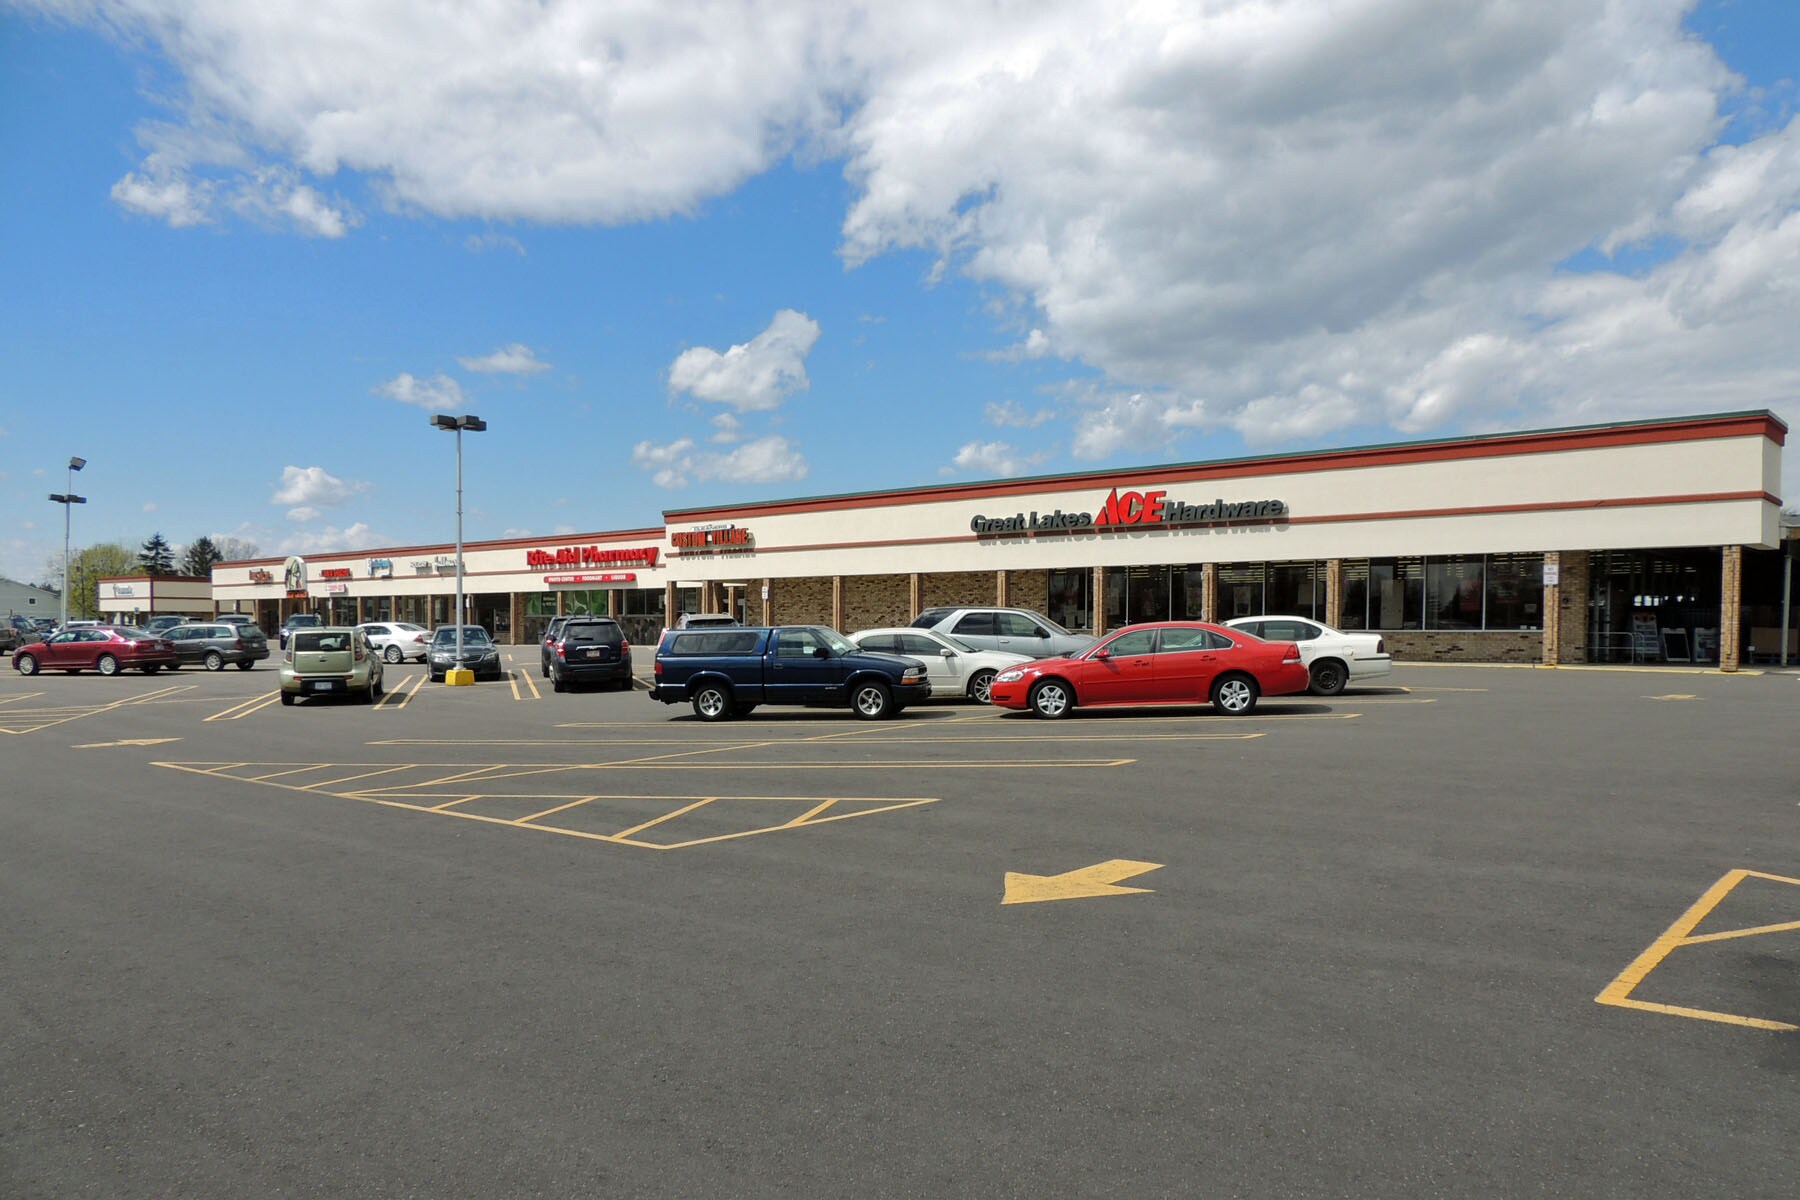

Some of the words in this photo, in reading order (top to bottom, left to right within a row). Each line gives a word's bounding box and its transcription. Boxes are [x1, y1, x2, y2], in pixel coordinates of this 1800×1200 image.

[970, 511, 1027, 533] Great
[1028, 509, 1091, 530] Lakes
[1094, 487, 1167, 526] ACE
[1165, 498, 1286, 523] Hardware
[671, 532, 706, 547] CUSTOM
[711, 528, 749, 545] VILLAGE
[527, 549, 555, 566] Rite
[556, 547, 580, 564] Aid
[582, 545, 659, 567] Pharmacy
